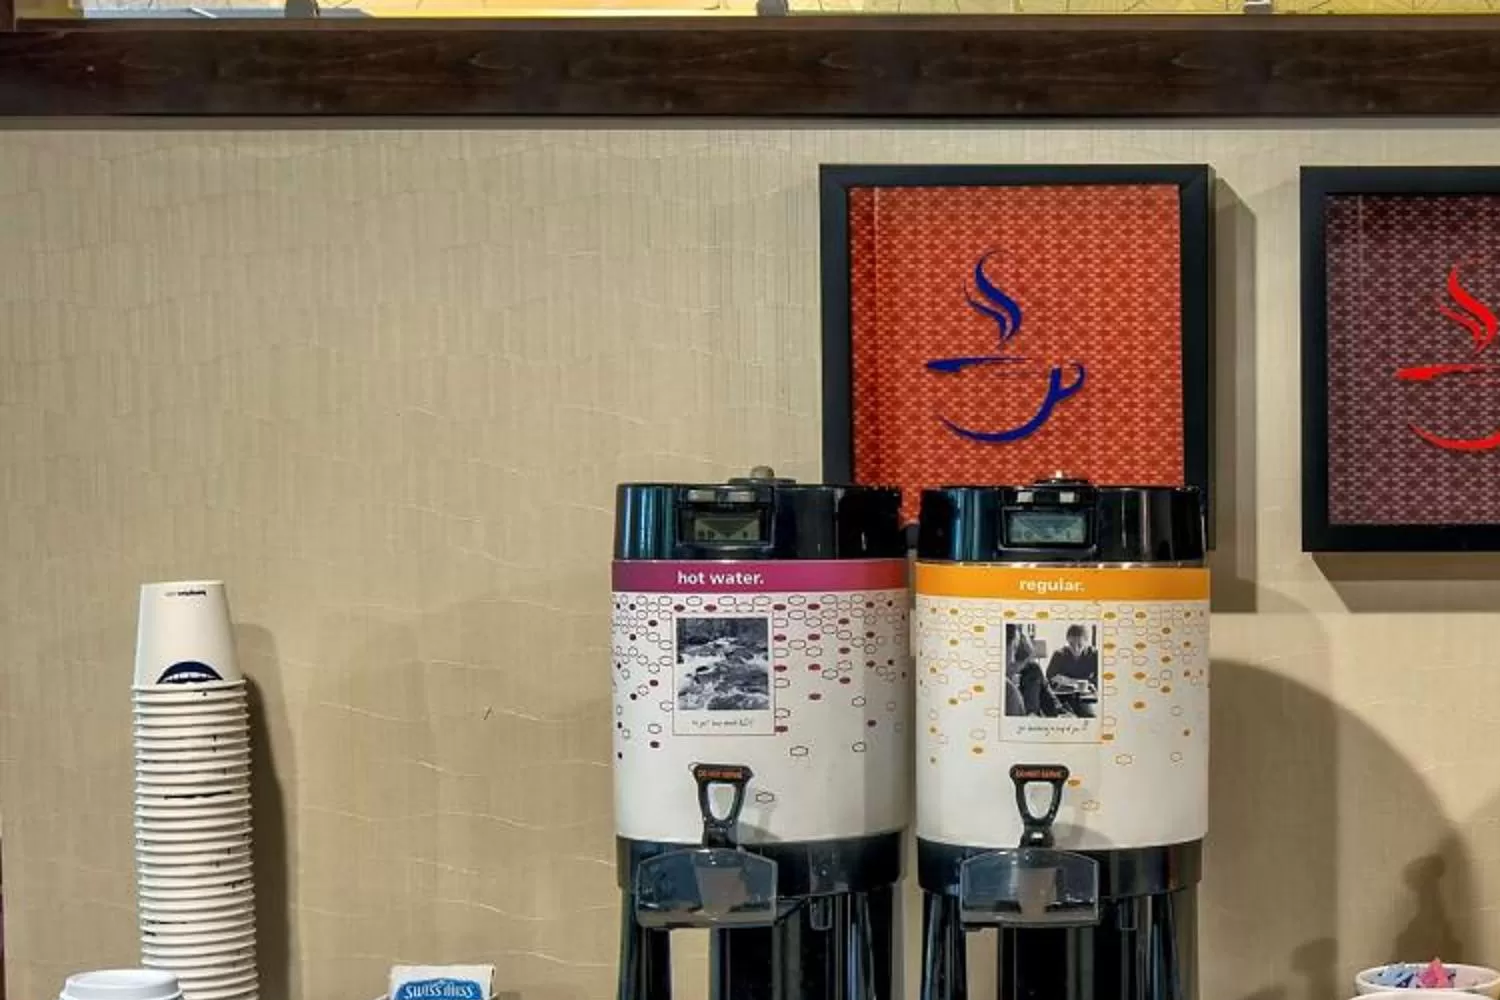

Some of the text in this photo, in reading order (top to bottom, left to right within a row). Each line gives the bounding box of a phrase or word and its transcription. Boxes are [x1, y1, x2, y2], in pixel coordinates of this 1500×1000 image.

[677, 570, 764, 585] hot water.
[1019, 577, 1086, 595] regular.
